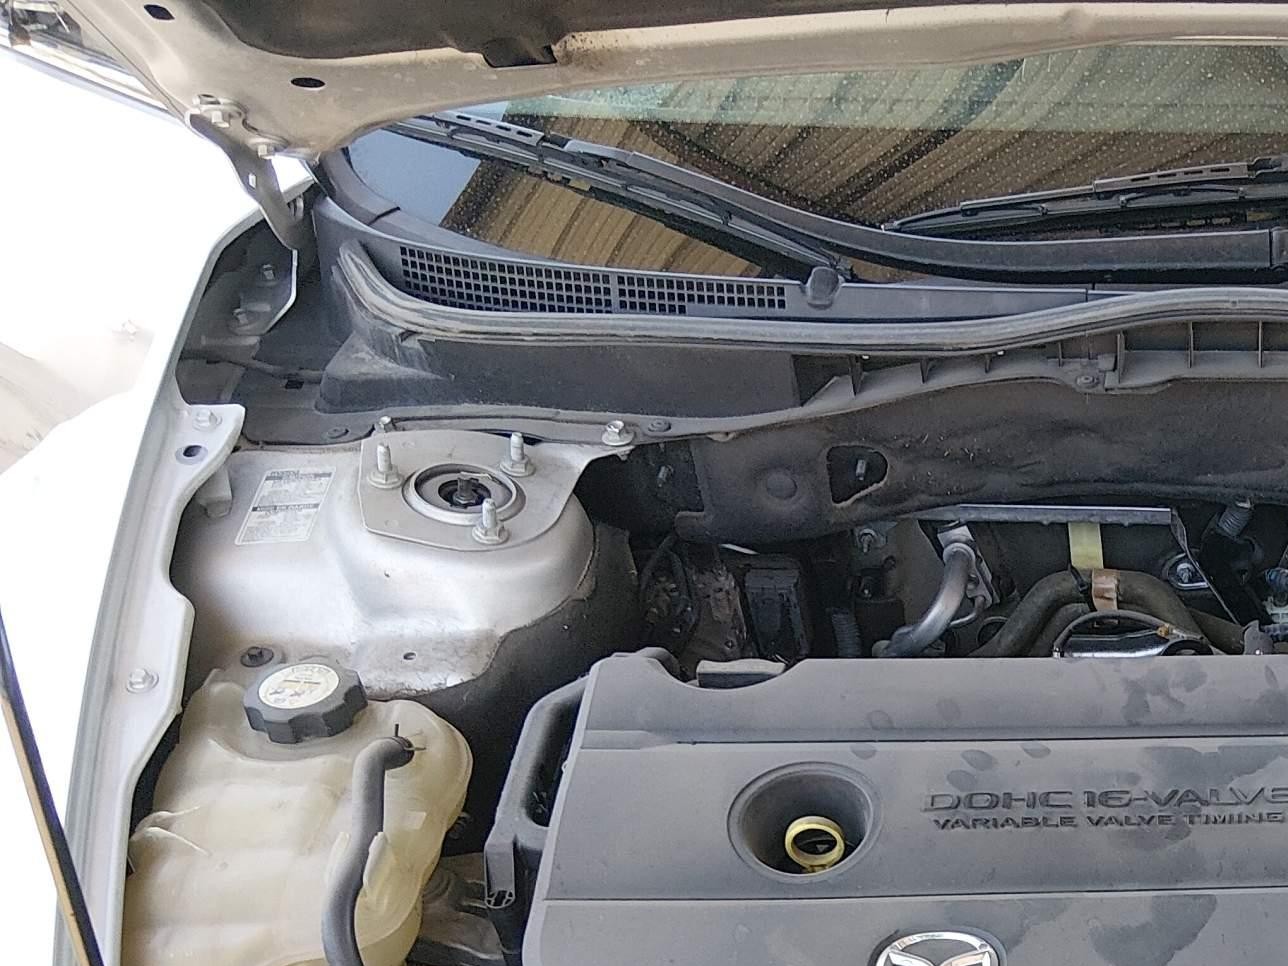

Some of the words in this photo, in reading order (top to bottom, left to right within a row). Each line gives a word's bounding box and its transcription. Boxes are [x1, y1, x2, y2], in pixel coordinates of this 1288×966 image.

[924, 790, 1073, 812] DOHC
[933, 815, 1078, 831] VARIABLE
[1086, 814, 1175, 828] VALVE
